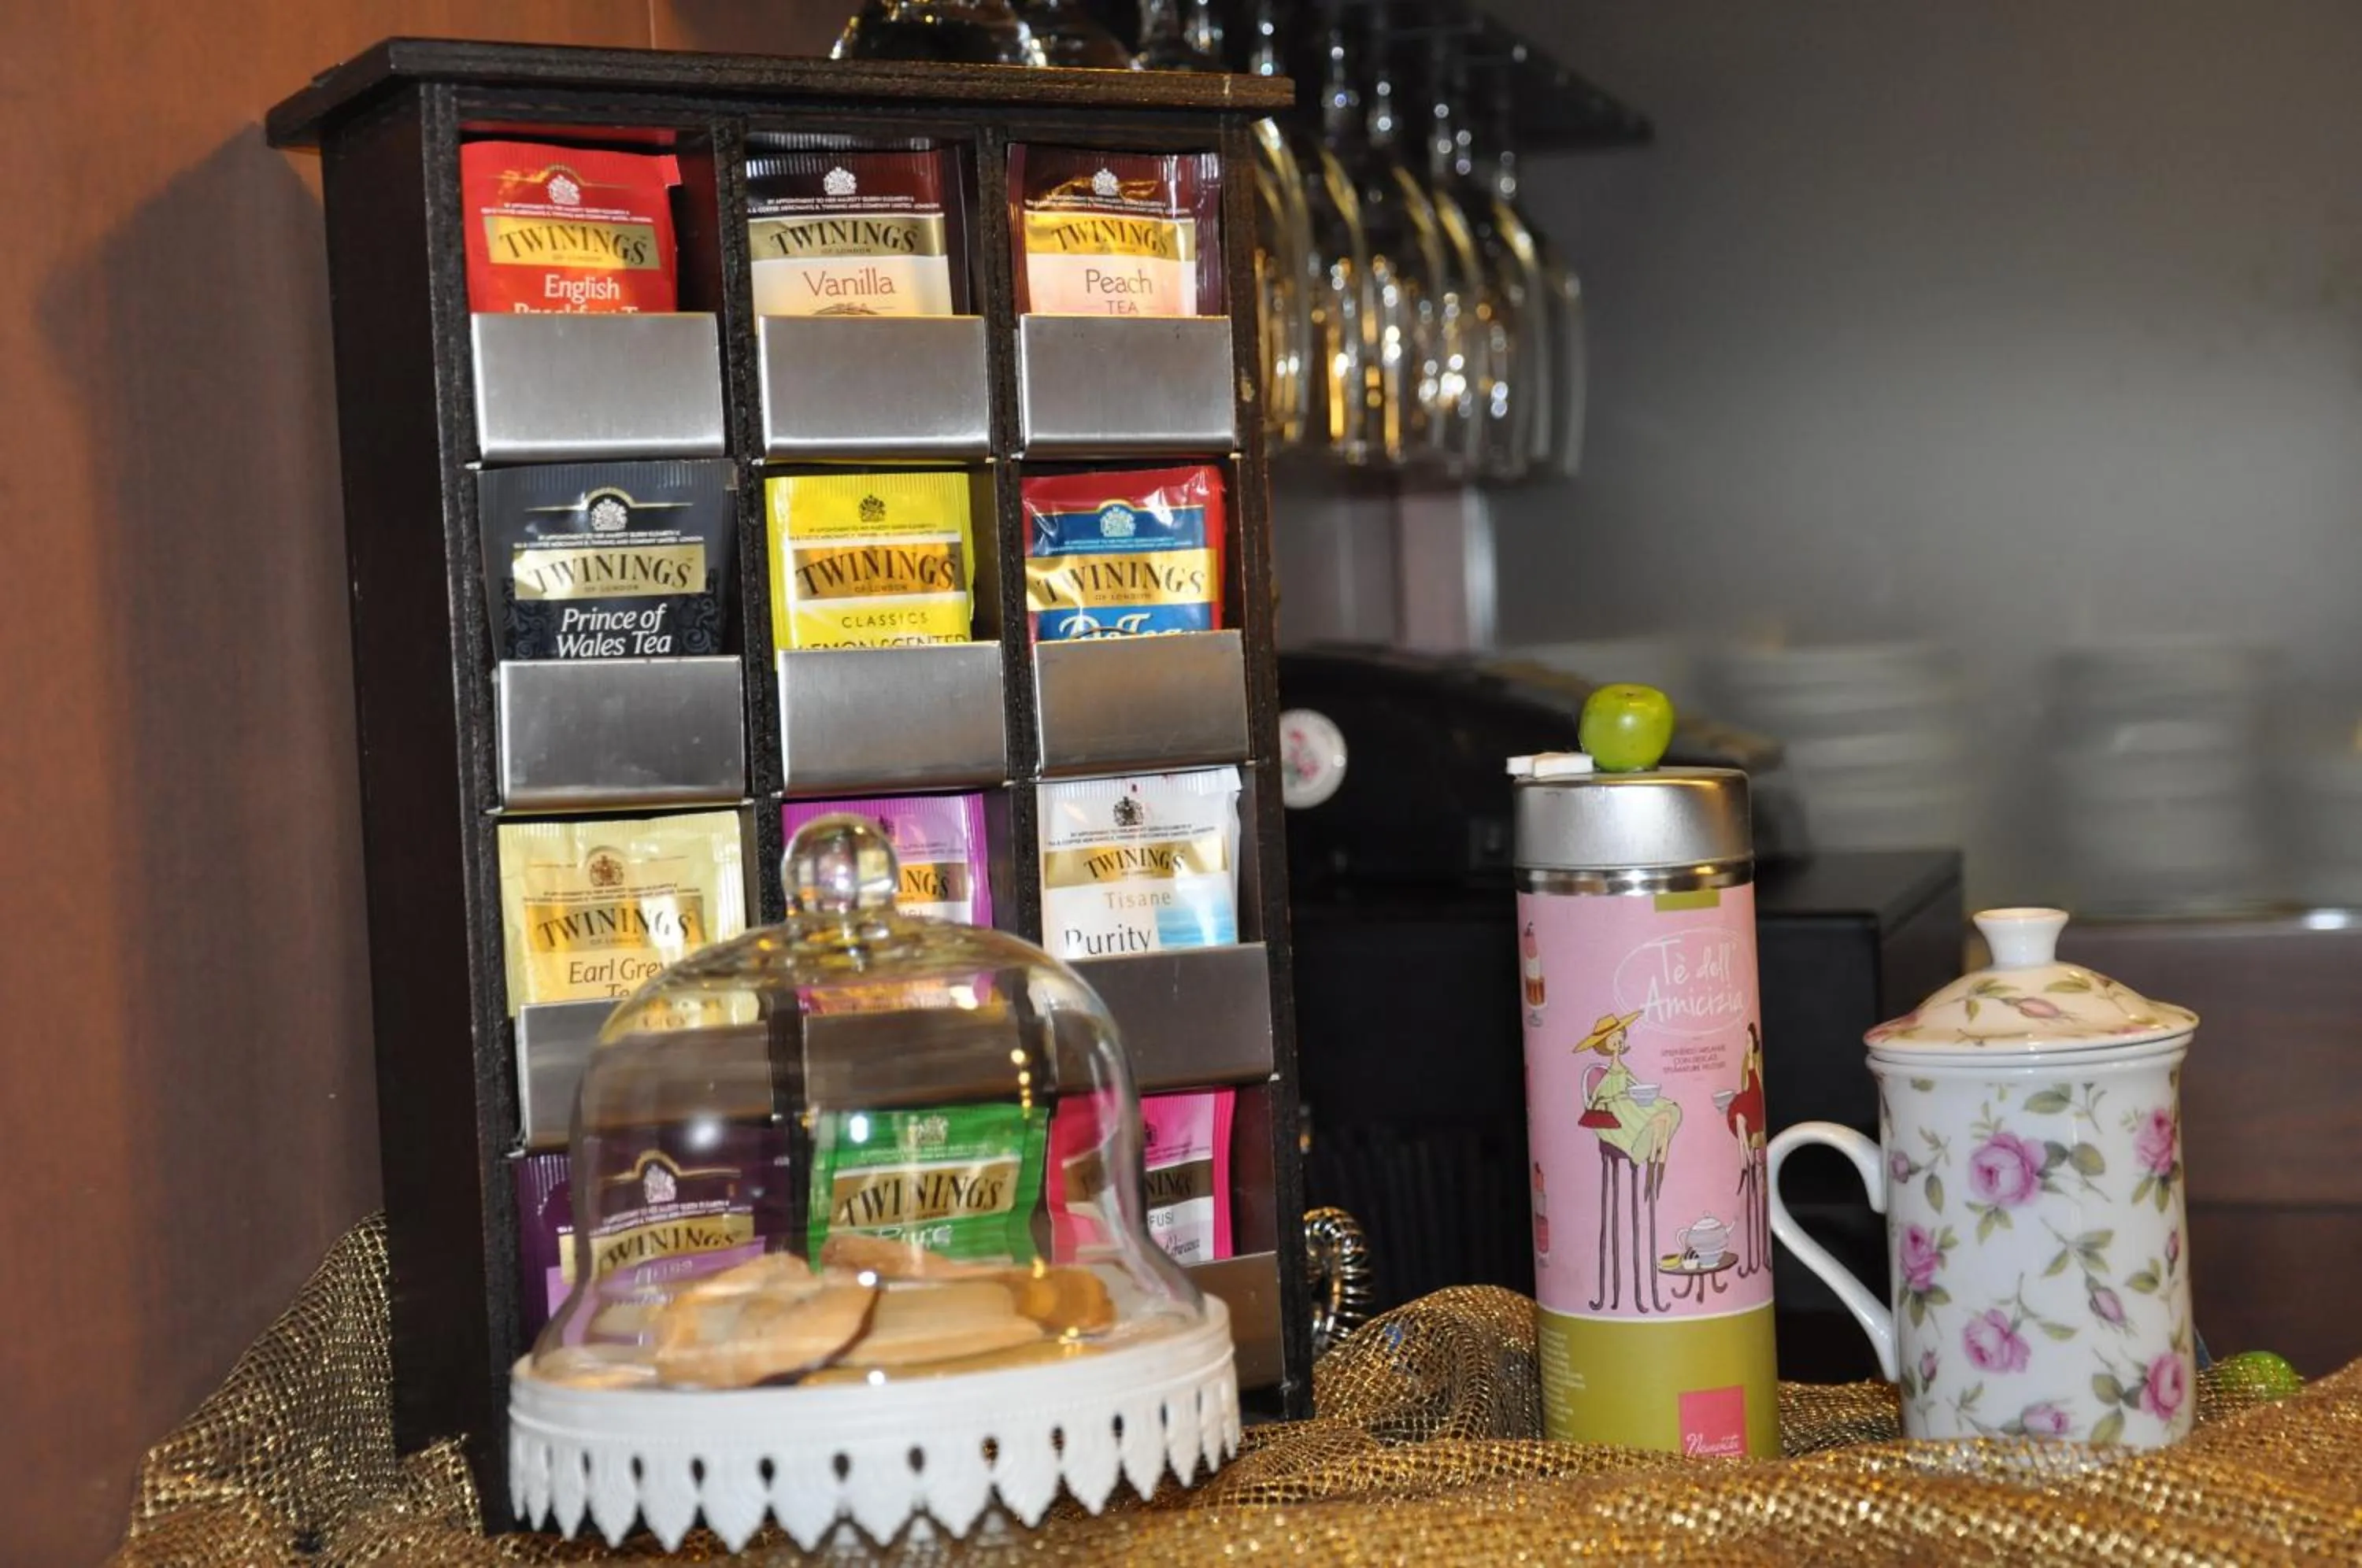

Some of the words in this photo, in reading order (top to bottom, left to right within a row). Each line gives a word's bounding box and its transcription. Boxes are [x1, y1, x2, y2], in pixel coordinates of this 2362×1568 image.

[500, 224, 646, 265] TWININGS
[770, 220, 917, 255] TWININGS
[1051, 220, 1168, 255] TWININGS
[545, 274, 620, 304] English
[802, 268, 896, 297] Vanilla
[1086, 268, 1153, 294] Peach
[1106, 300, 1138, 314] TEA
[528, 553, 691, 594] TWININGS
[795, 549, 956, 596] TWININGS
[561, 606, 638, 632] Prince
[640, 602, 668, 633] of
[842, 612, 928, 629] CLASSICS
[556, 632, 627, 658] Wales
[631, 631, 672, 655] Tea
[1083, 847, 1184, 879] TWININGS
[1105, 890, 1172, 909] Tisane
[537, 907, 693, 948] TWININGS
[1065, 923, 1152, 956] Purity
[569, 959, 615, 985] Earl
[1642, 938, 1690, 986] Tè
[1640, 974, 1744, 1023] Amicizia
[836, 1174, 1004, 1227] TWININGS
